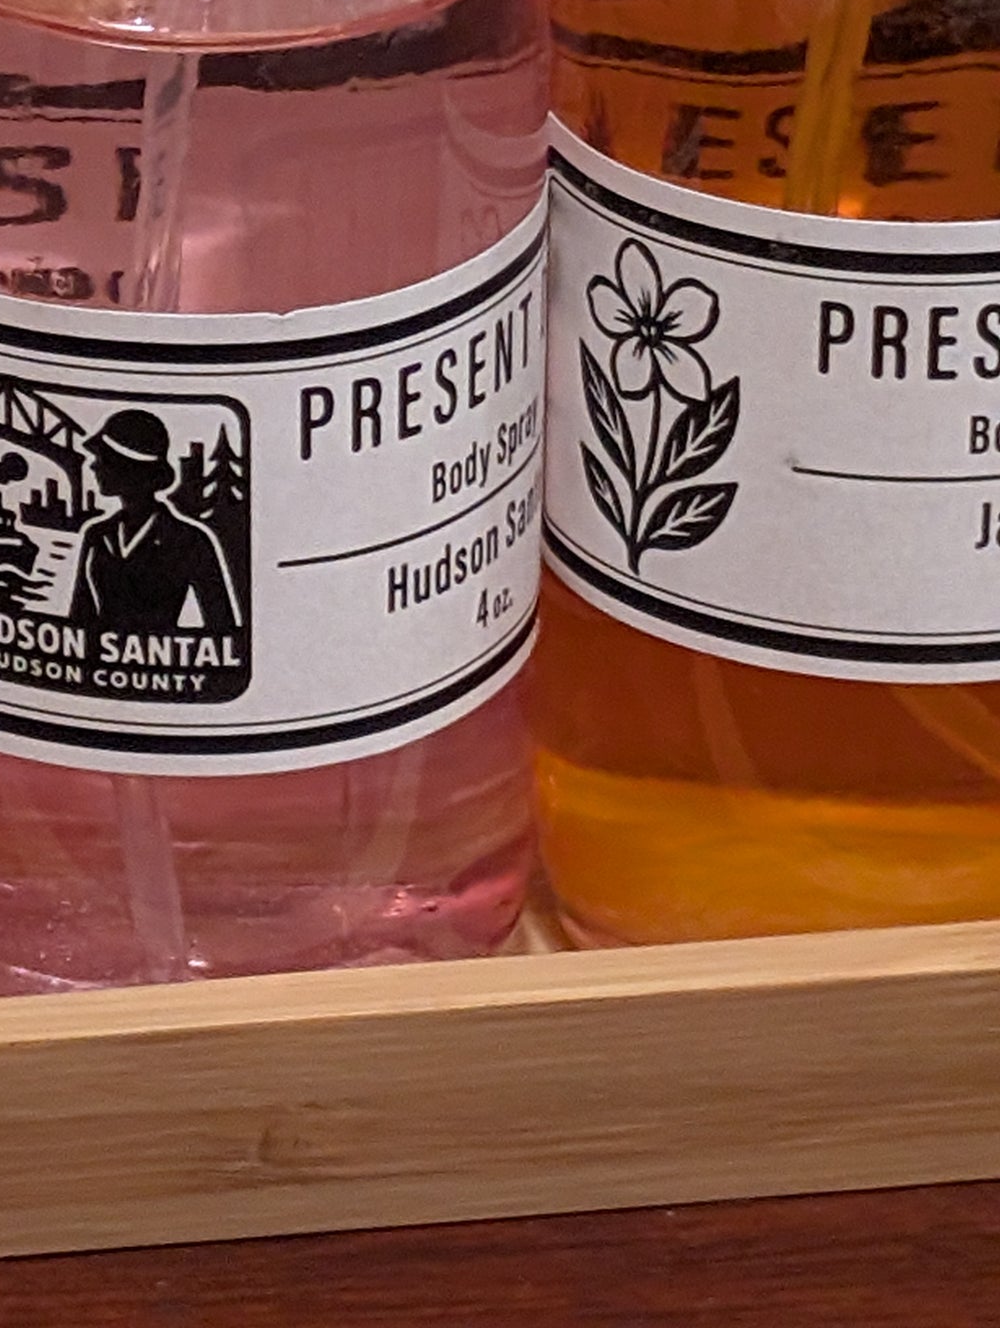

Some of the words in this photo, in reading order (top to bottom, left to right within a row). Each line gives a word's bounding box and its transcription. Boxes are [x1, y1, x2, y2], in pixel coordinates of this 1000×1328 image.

[300, 290, 533, 461] PRESENT
[432, 440, 491, 504] Body
[387, 524, 499, 615] Hudson
[505, 486, 537, 549] San
[476, 587, 490, 628] 4
[99, 630, 241, 668] SANTAL
[92, 668, 207, 693] COUNTY
